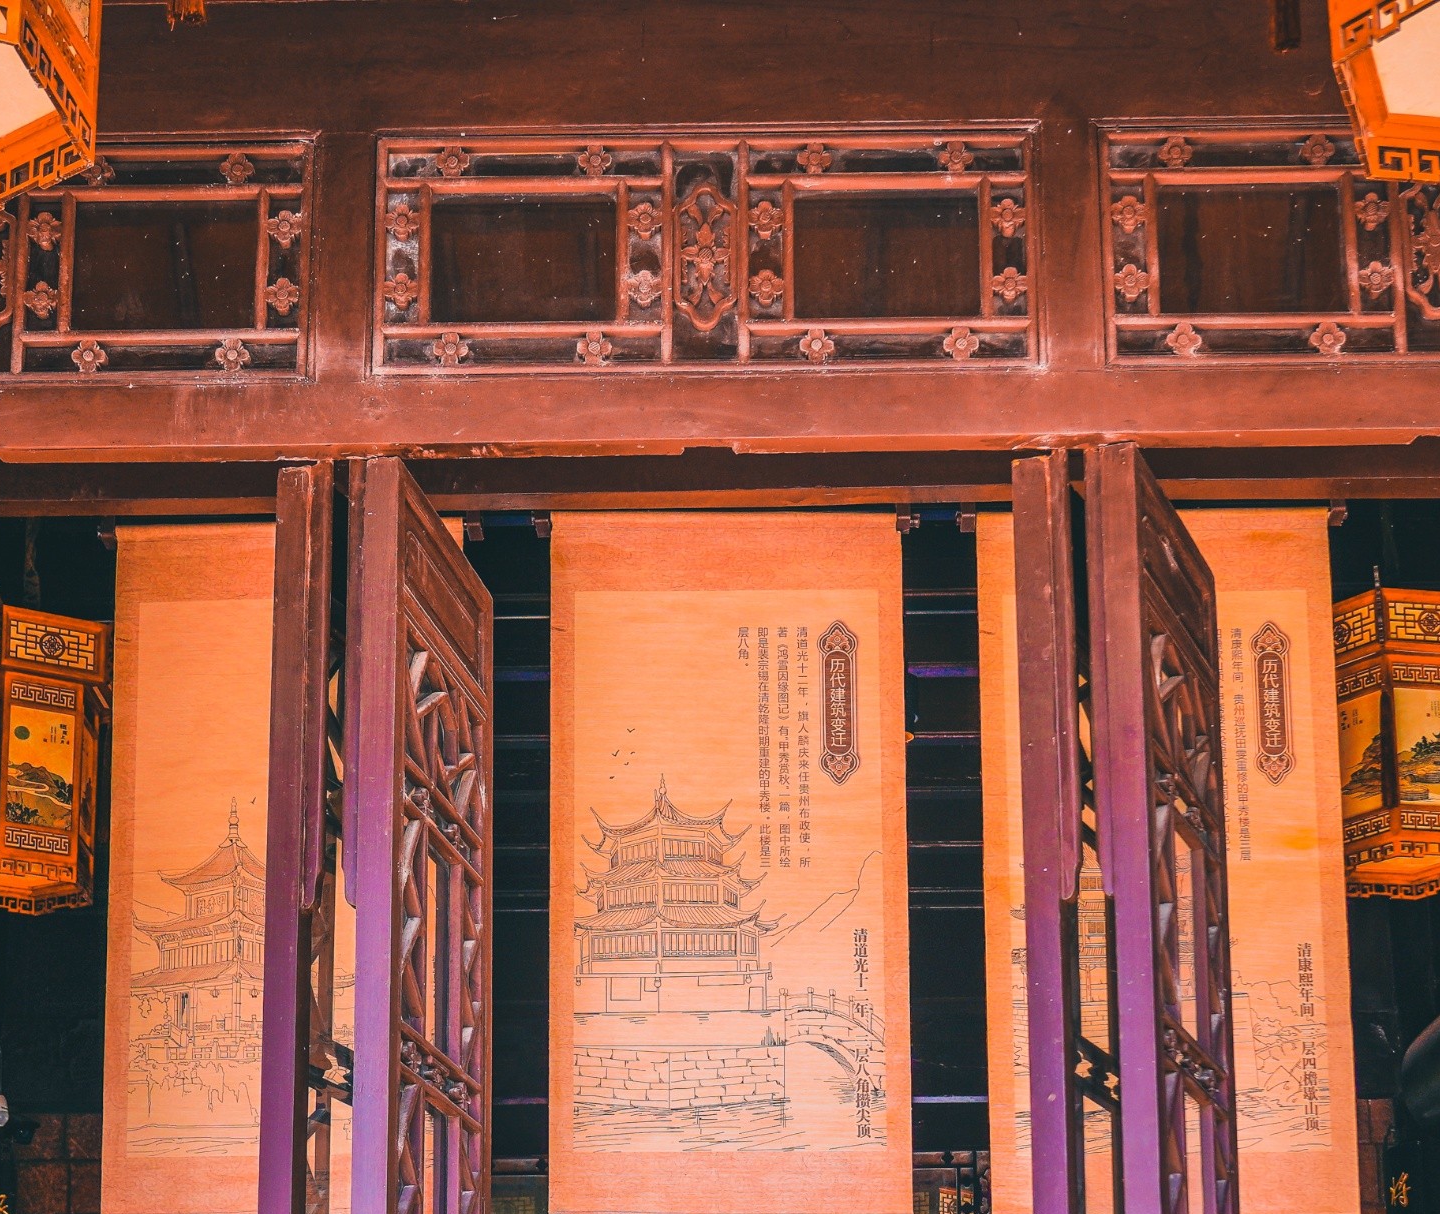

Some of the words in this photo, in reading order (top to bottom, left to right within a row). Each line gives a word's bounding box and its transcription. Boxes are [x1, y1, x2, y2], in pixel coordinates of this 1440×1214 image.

[737, 626, 750, 667] 层八角。
[830, 658, 847, 748] 历代建筑变迁
[1262, 659, 1282, 748] 历代建筑变迁
